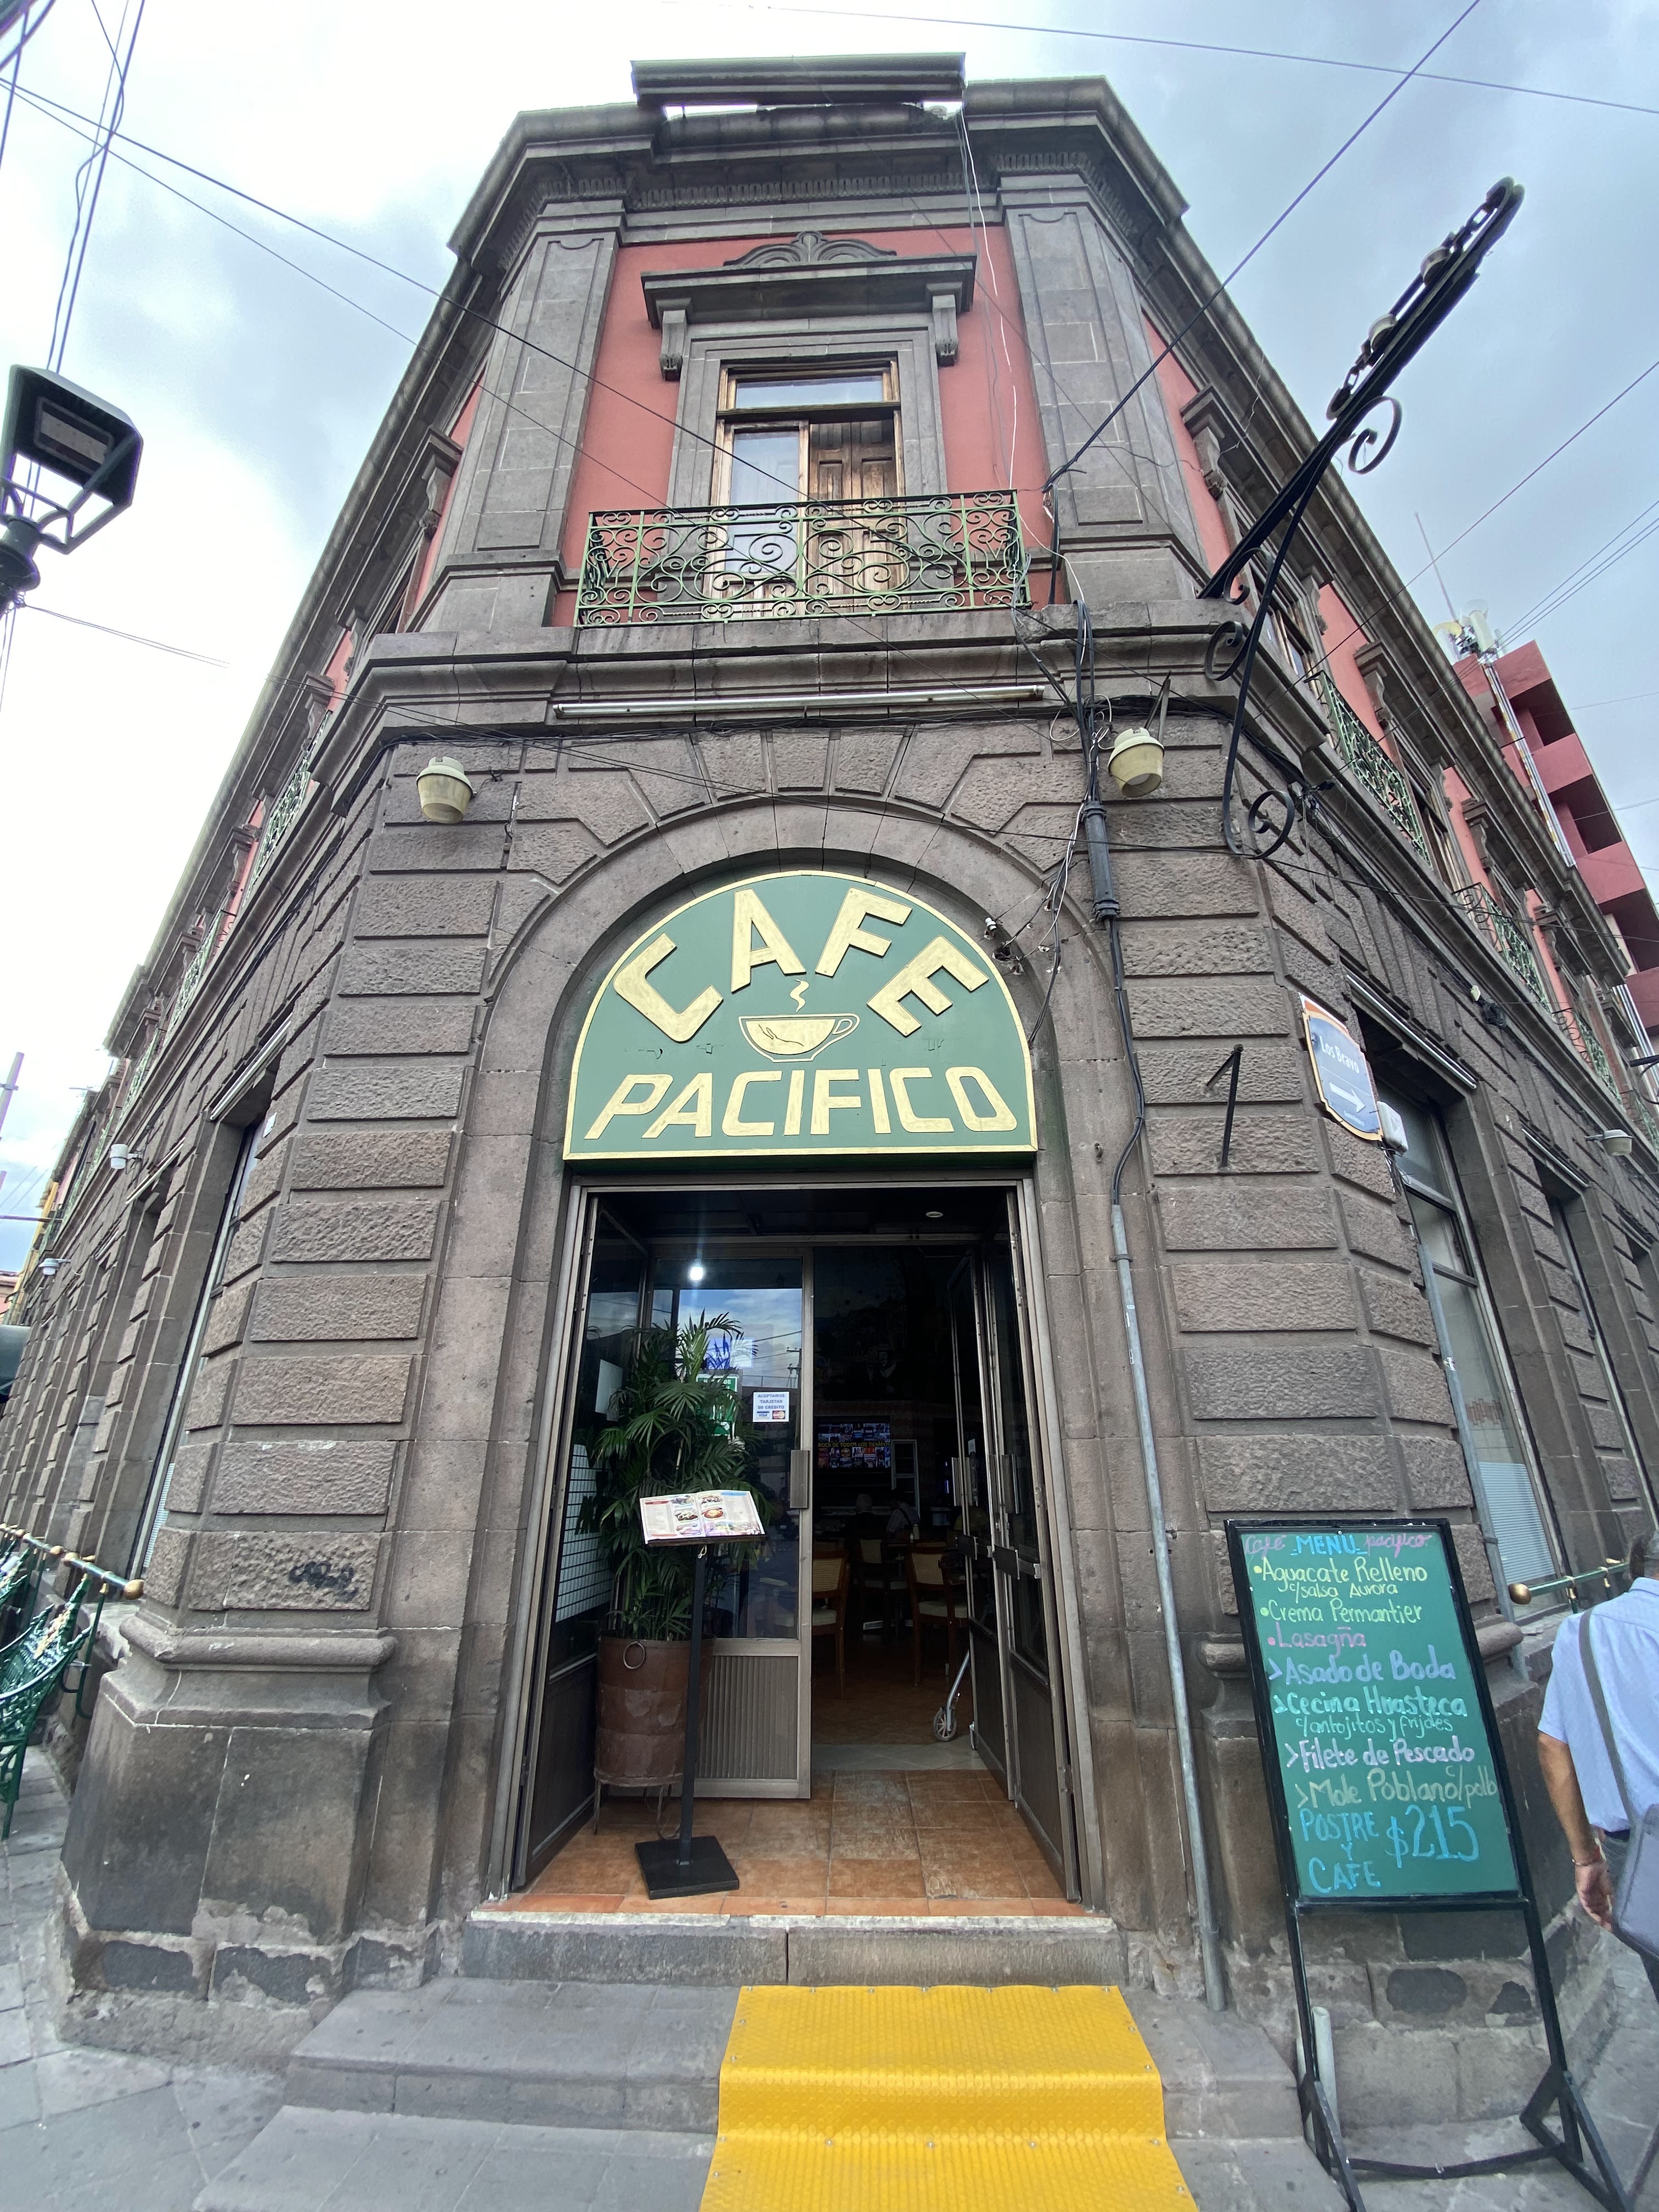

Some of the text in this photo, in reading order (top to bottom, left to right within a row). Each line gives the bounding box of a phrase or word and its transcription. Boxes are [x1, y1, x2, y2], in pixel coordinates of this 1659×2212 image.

[613, 887, 990, 1042] CAFE
[1319, 1035, 1335, 1058] Los
[584, 1066, 1018, 1139] PACIFICO
[1262, 1556, 1427, 1592] Aguacate Relleno
[1349, 1582, 1398, 1598] Aurora
[1268, 1599, 1324, 1622] Crema
[1285, 1644, 1457, 1685] Asado de Boda
[1286, 1685, 1468, 1718] Cecina Huasteca
[1387, 1718, 1397, 1742] y
[1299, 1735, 1475, 1773] Filete de Pescado
[1309, 1773, 1362, 1809] Mole
[1367, 1767, 1458, 1802] Poblano
[1300, 1804, 1480, 1869] POSTRE $215
[1341, 1842, 1353, 1861] Y
[1308, 1857, 1381, 1893] CAFE
